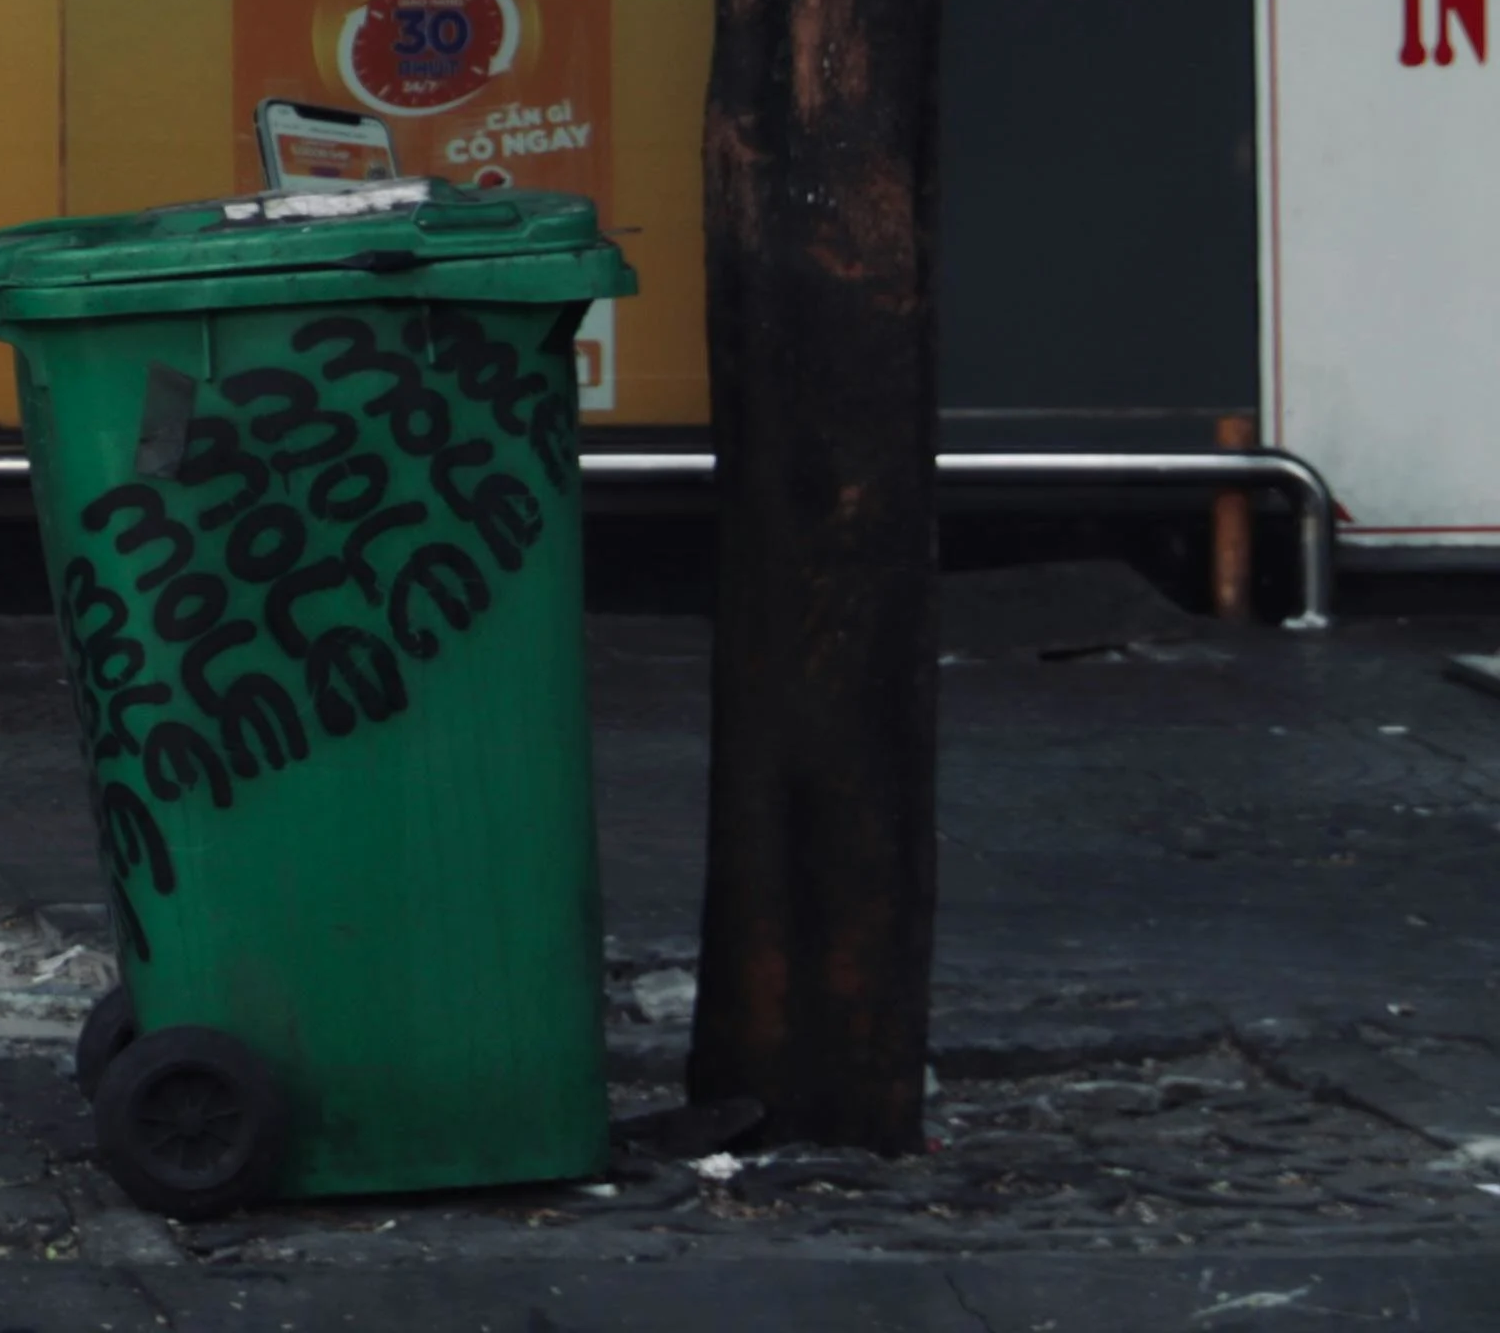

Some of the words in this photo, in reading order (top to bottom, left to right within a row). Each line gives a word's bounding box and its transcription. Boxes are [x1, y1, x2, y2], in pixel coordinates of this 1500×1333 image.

[394, 8, 469, 55] 30
[445, 129, 494, 164] CÓ
[501, 121, 592, 158] NGAY
